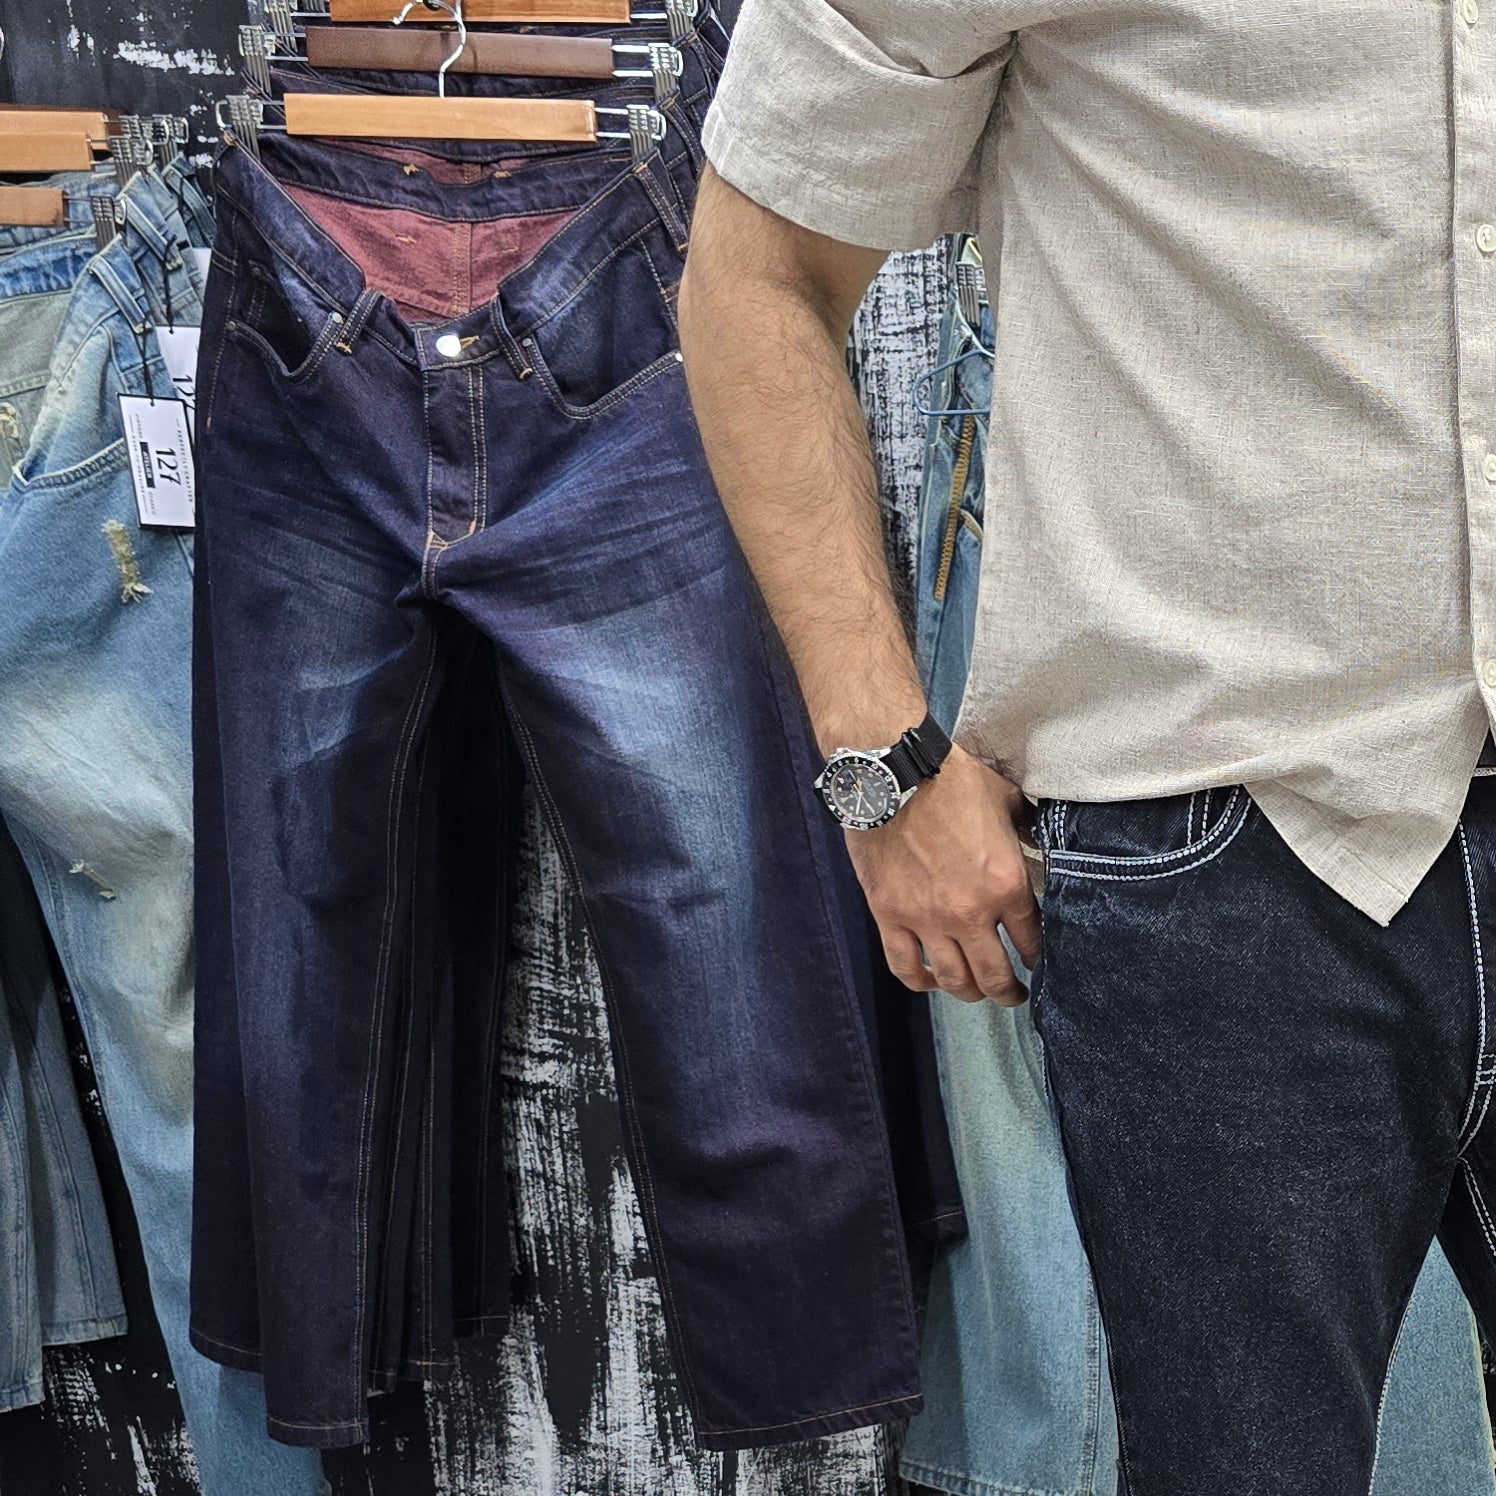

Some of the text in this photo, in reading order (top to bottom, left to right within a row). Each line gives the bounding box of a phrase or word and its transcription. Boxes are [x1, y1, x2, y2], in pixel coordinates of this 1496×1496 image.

[172, 375, 196, 410] 12
[143, 450, 153, 479] ATELIER
[156, 448, 181, 486] 127
